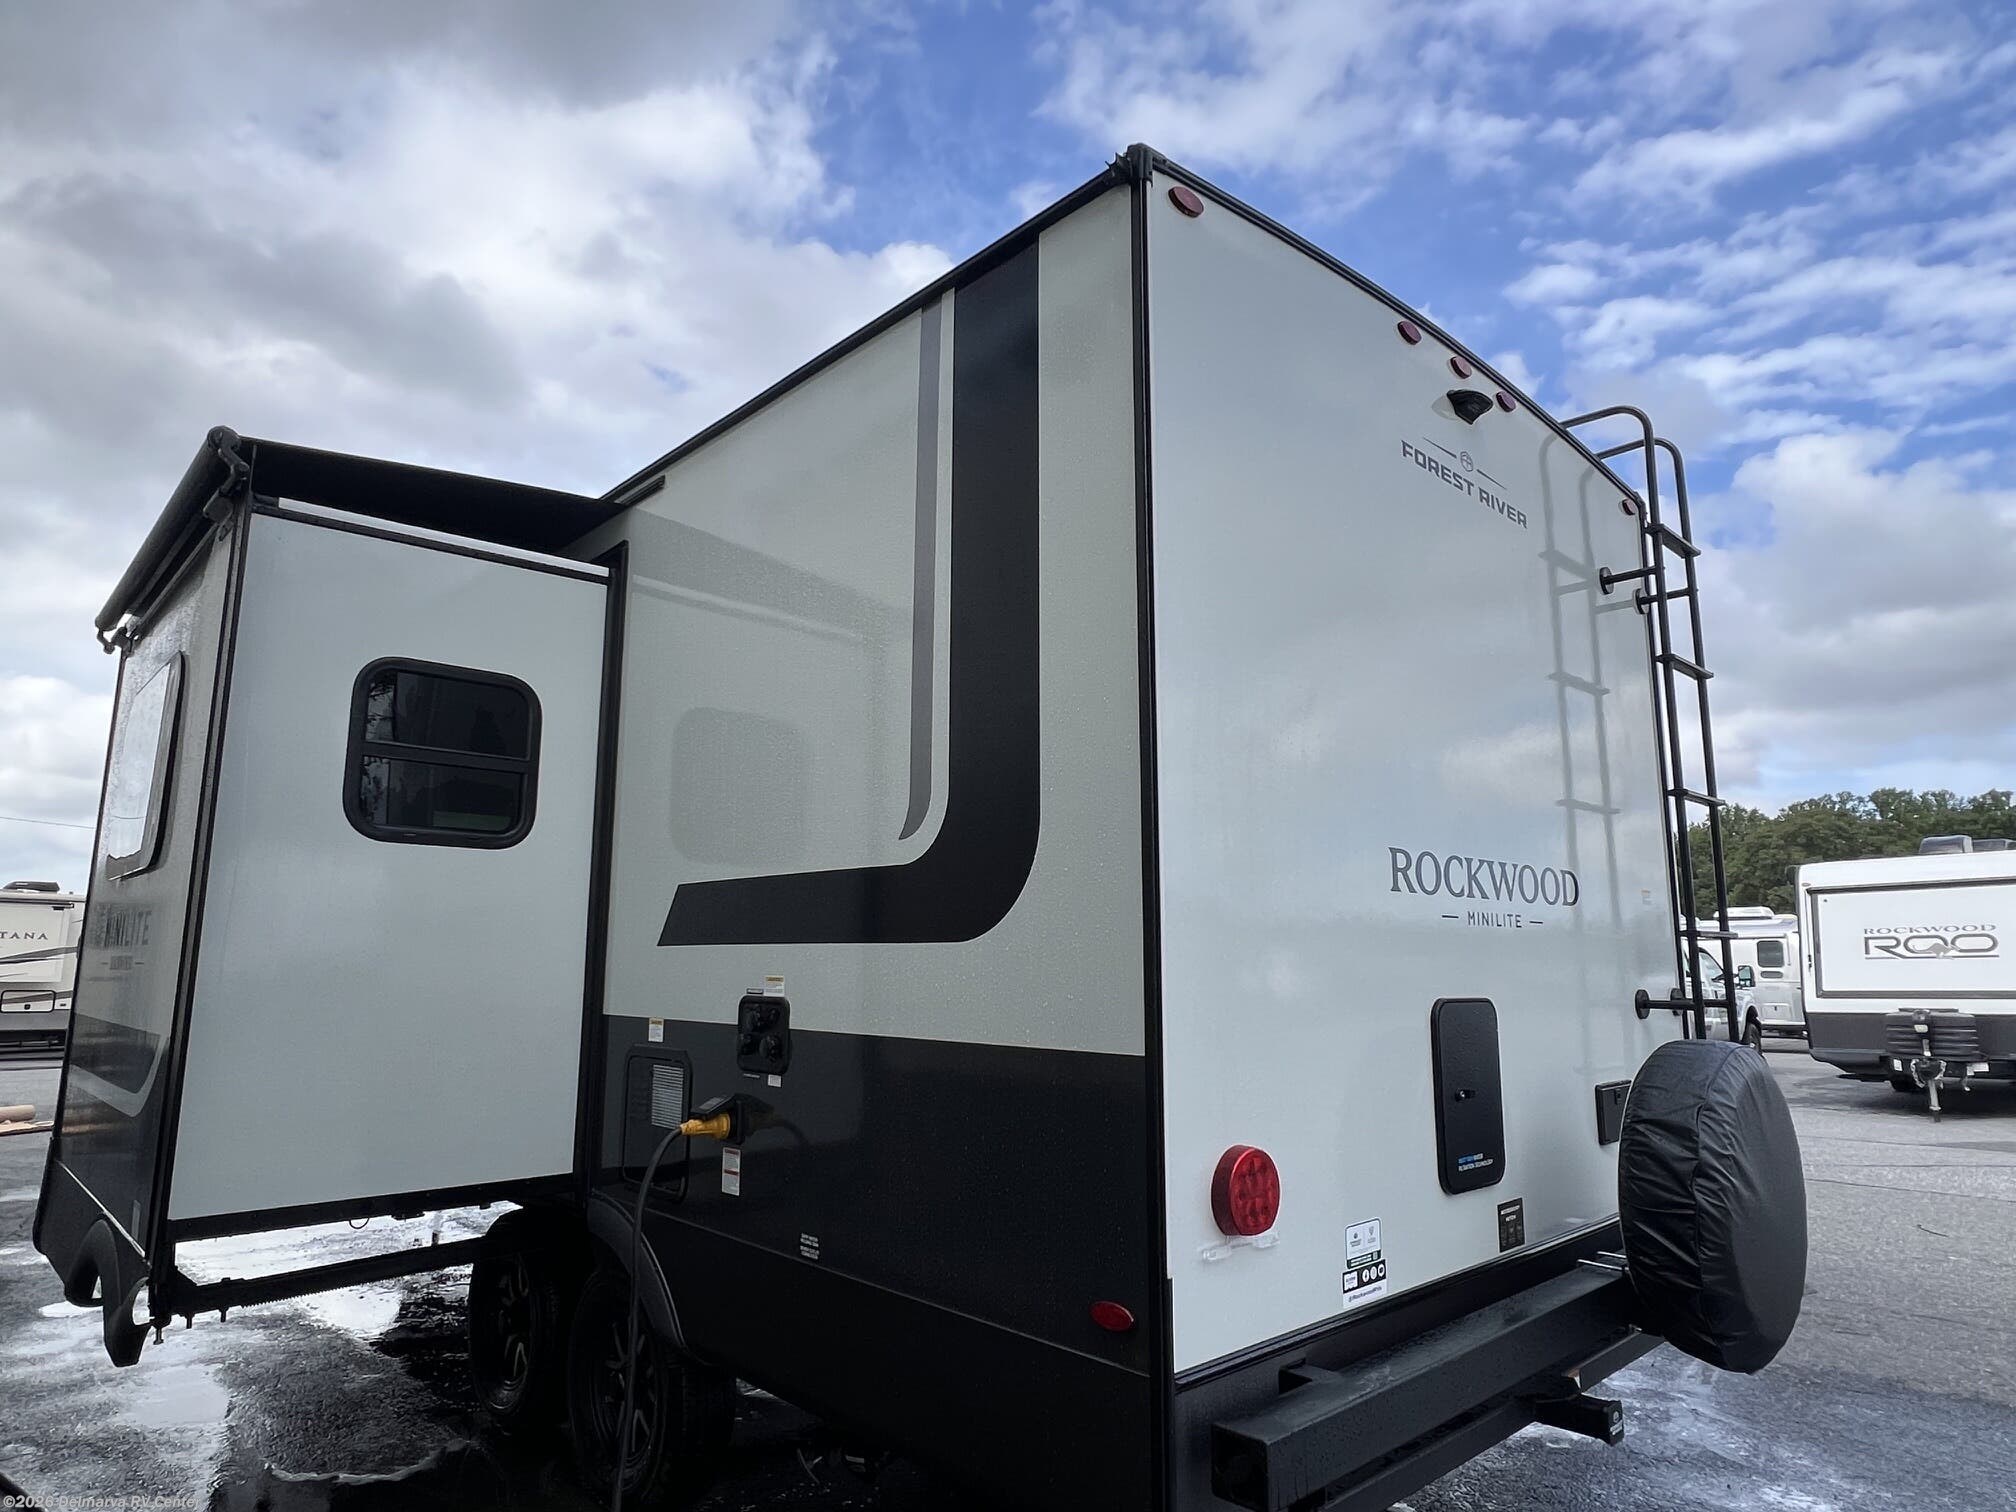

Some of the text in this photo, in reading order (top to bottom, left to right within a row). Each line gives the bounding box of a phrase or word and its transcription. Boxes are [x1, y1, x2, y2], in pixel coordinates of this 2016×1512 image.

[1401, 439, 1528, 529] FOREST RIVER
[1388, 846, 1580, 907] ROCKWOOD
[1467, 910, 1523, 928] MINILITE
[1863, 924, 1997, 934] ROCKWOOD
[1863, 934, 1999, 959] ROO
